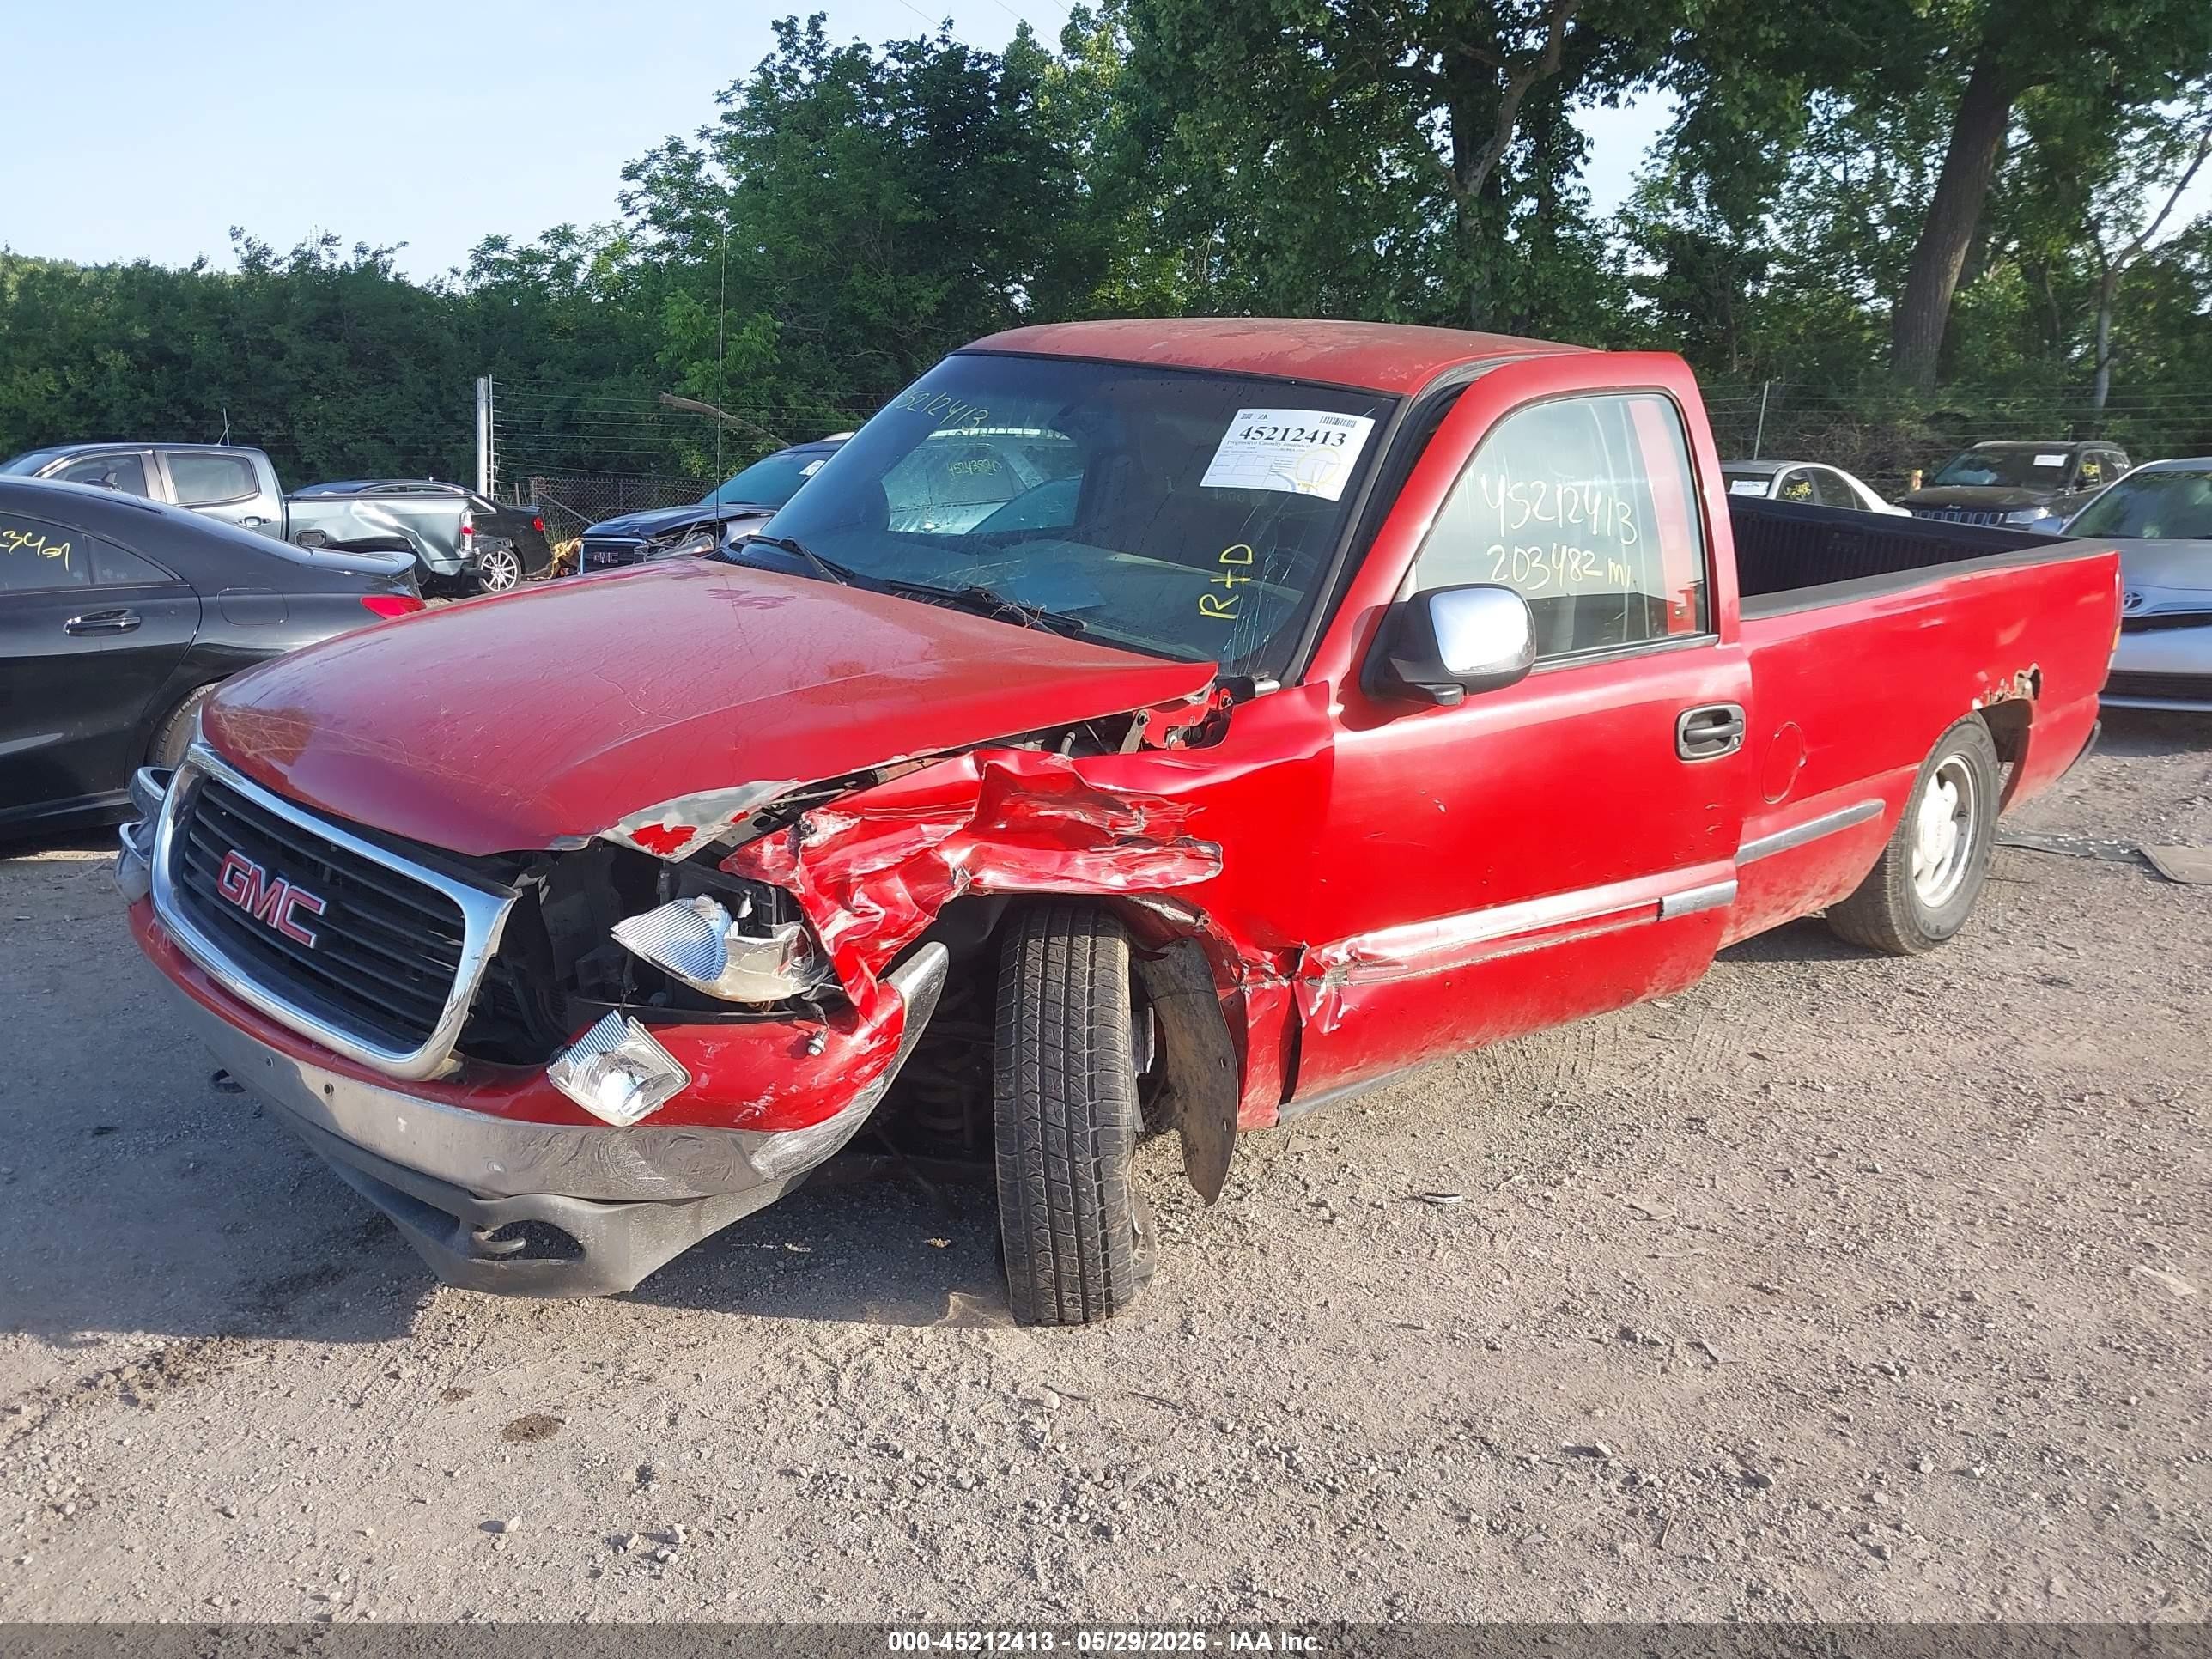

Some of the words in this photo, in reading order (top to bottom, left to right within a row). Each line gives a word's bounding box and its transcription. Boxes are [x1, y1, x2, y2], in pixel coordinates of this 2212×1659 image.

[896, 391, 988, 428] 5212413
[1239, 425, 1346, 447] 45212413
[1480, 474, 1637, 545] 45212413
[593, 551, 618, 563] GMC
[1486, 543, 1603, 590] 203482
[217, 849, 327, 949] GMC
